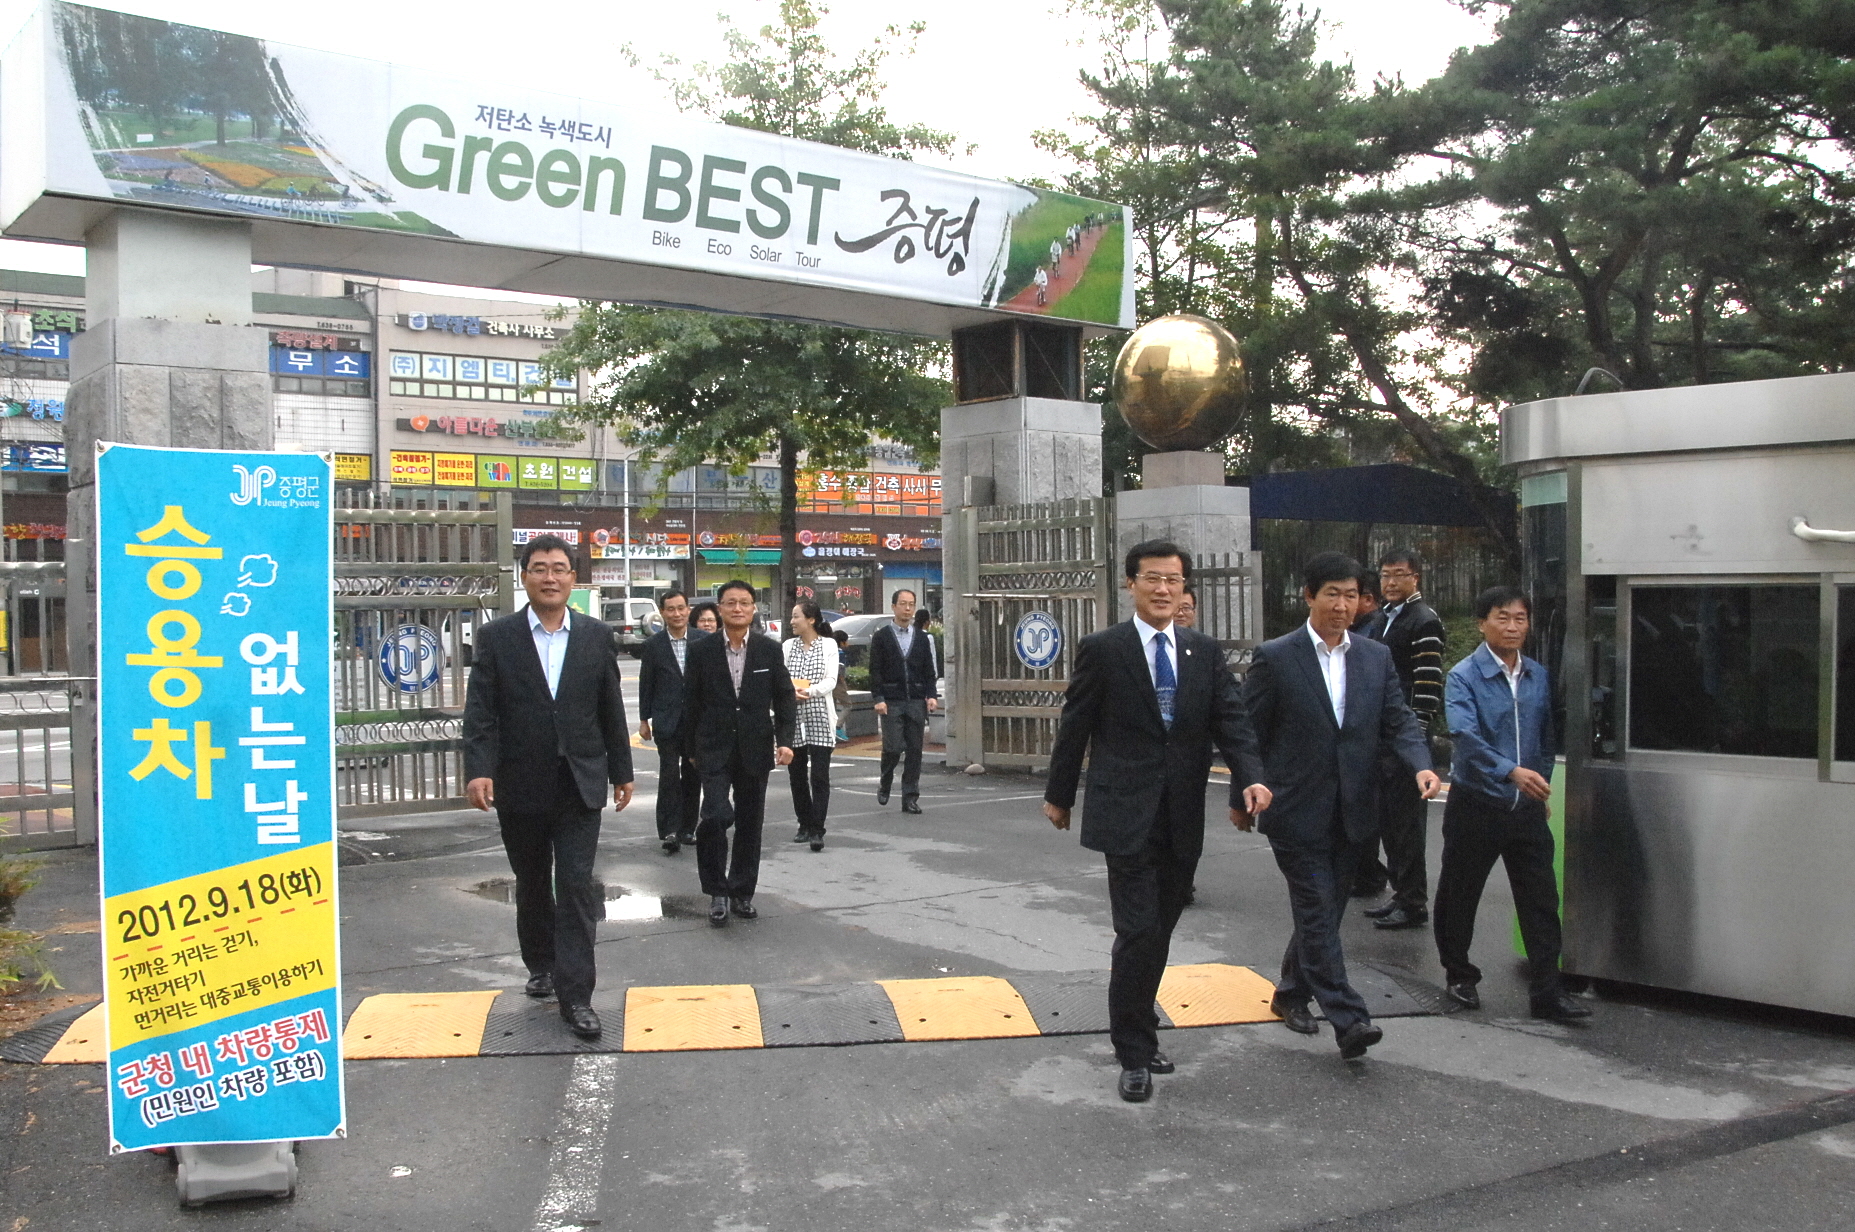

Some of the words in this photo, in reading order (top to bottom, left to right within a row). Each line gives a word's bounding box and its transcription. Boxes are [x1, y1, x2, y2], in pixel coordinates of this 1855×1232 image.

[475, 104, 533, 132] 저탄소
[539, 116, 612, 149] 녹색도시
[386, 103, 626, 216] Green
[642, 144, 841, 245] BEST
[652, 230, 681, 249] Bike
[707, 238, 732, 256] Eco
[749, 244, 783, 263] Solar
[795, 252, 822, 269] Tour
[834, 188, 980, 277] 증평
[487, 320, 519, 336] 건축사
[523, 324, 555, 339] 사무소
[392, 355, 417, 376] (주)
[437, 415, 499, 437] 아름다운
[279, 476, 320, 499] 증평군
[523, 463, 554, 481] 초원
[562, 465, 593, 485] 건설
[263, 498, 288, 509] Jeung
[289, 498, 320, 509] Pyeong
[125, 505, 226, 799] 승용차
[410, 628, 438, 646] PEONG
[117, 866, 322, 943] 2012.9.18(화)
[120, 957, 168, 982] 가까운
[171, 943, 218, 967] 거리는
[221, 930, 259, 954] 걷기,
[126, 970, 206, 1006] 자전거타기
[134, 1000, 198, 1030] 먼거리는
[200, 959, 324, 1010] 대중교통이용하기
[119, 1052, 173, 1096] 군청
[180, 1044, 213, 1076] 내
[216, 1010, 330, 1064] 차량통제
[142, 1083, 217, 1126] (민원인
[221, 1067, 267, 1099] 차량
[273, 1052, 324, 1083] 포함)
